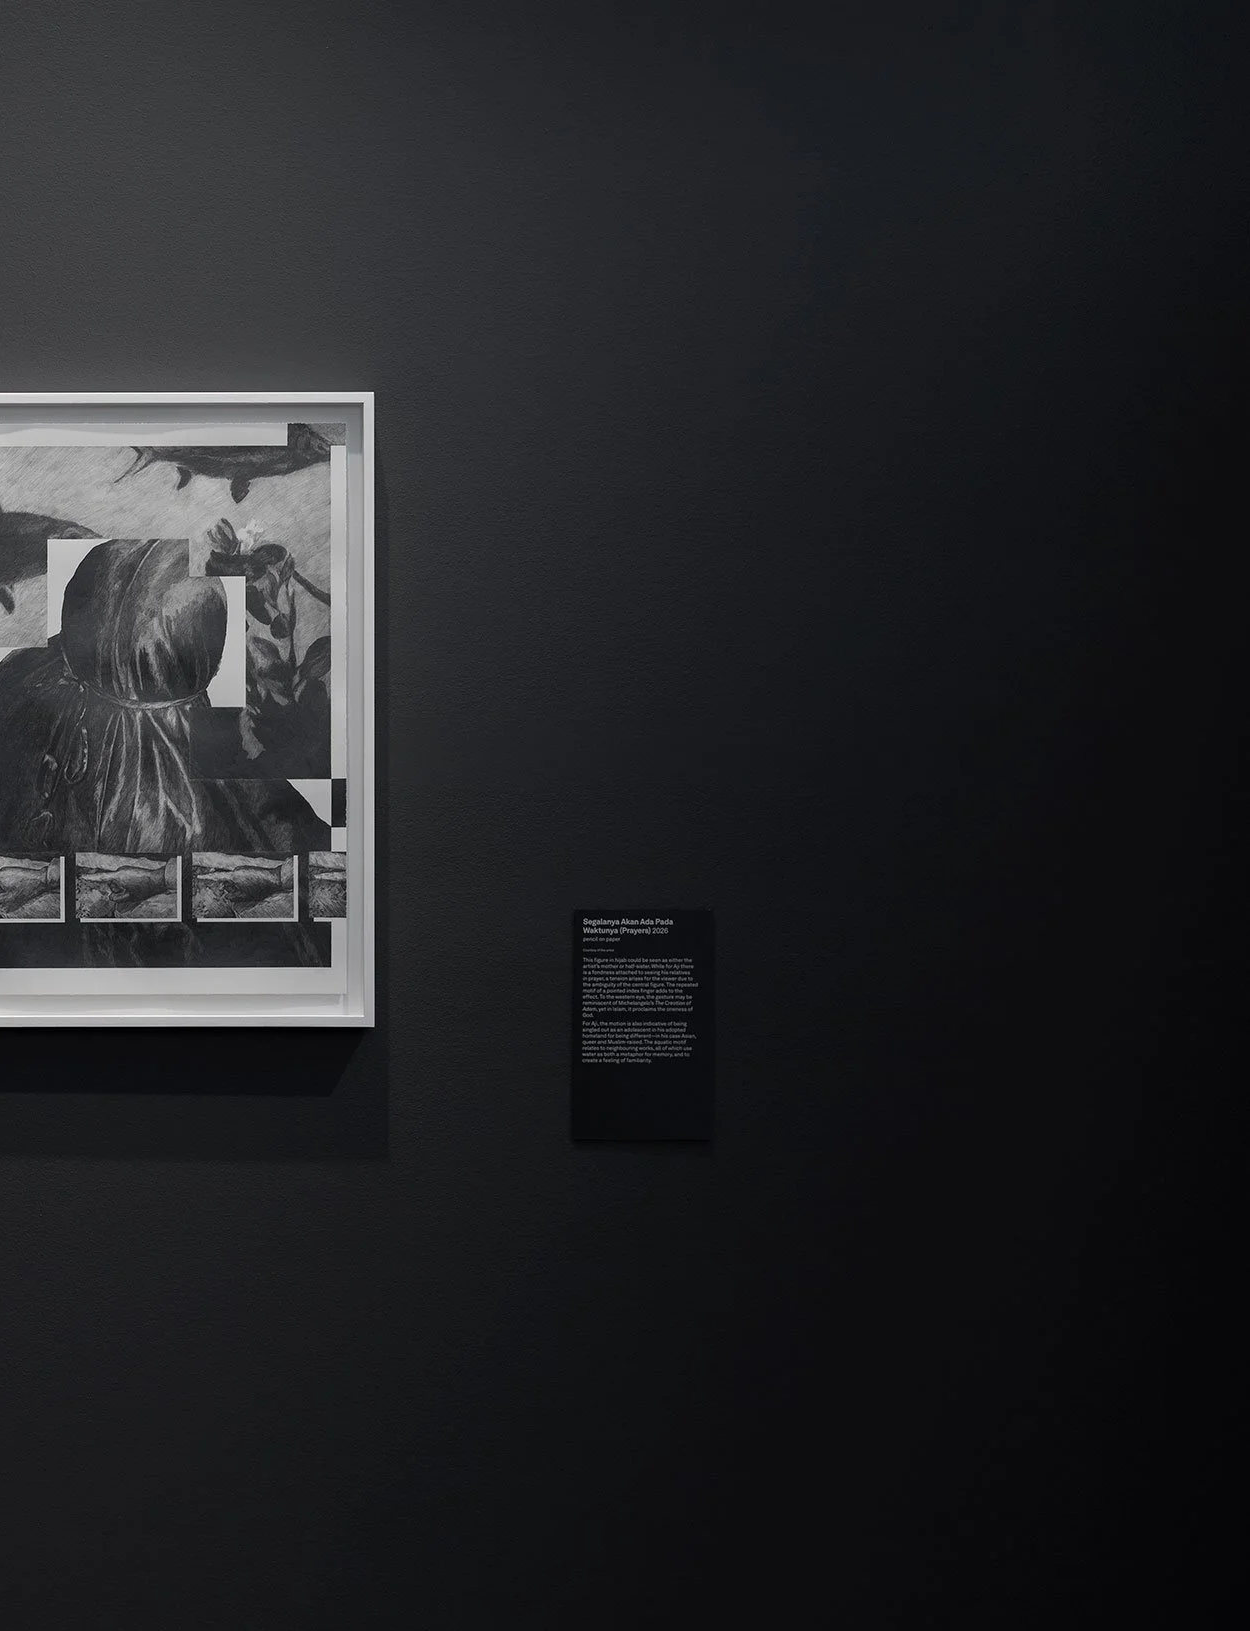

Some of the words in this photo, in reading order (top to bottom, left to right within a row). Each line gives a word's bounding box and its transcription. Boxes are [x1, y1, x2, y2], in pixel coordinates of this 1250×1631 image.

[583, 918, 619, 926] Segalanya
[583, 927, 619, 935] Waktunya
[620, 927, 651, 935] (Prayers)
